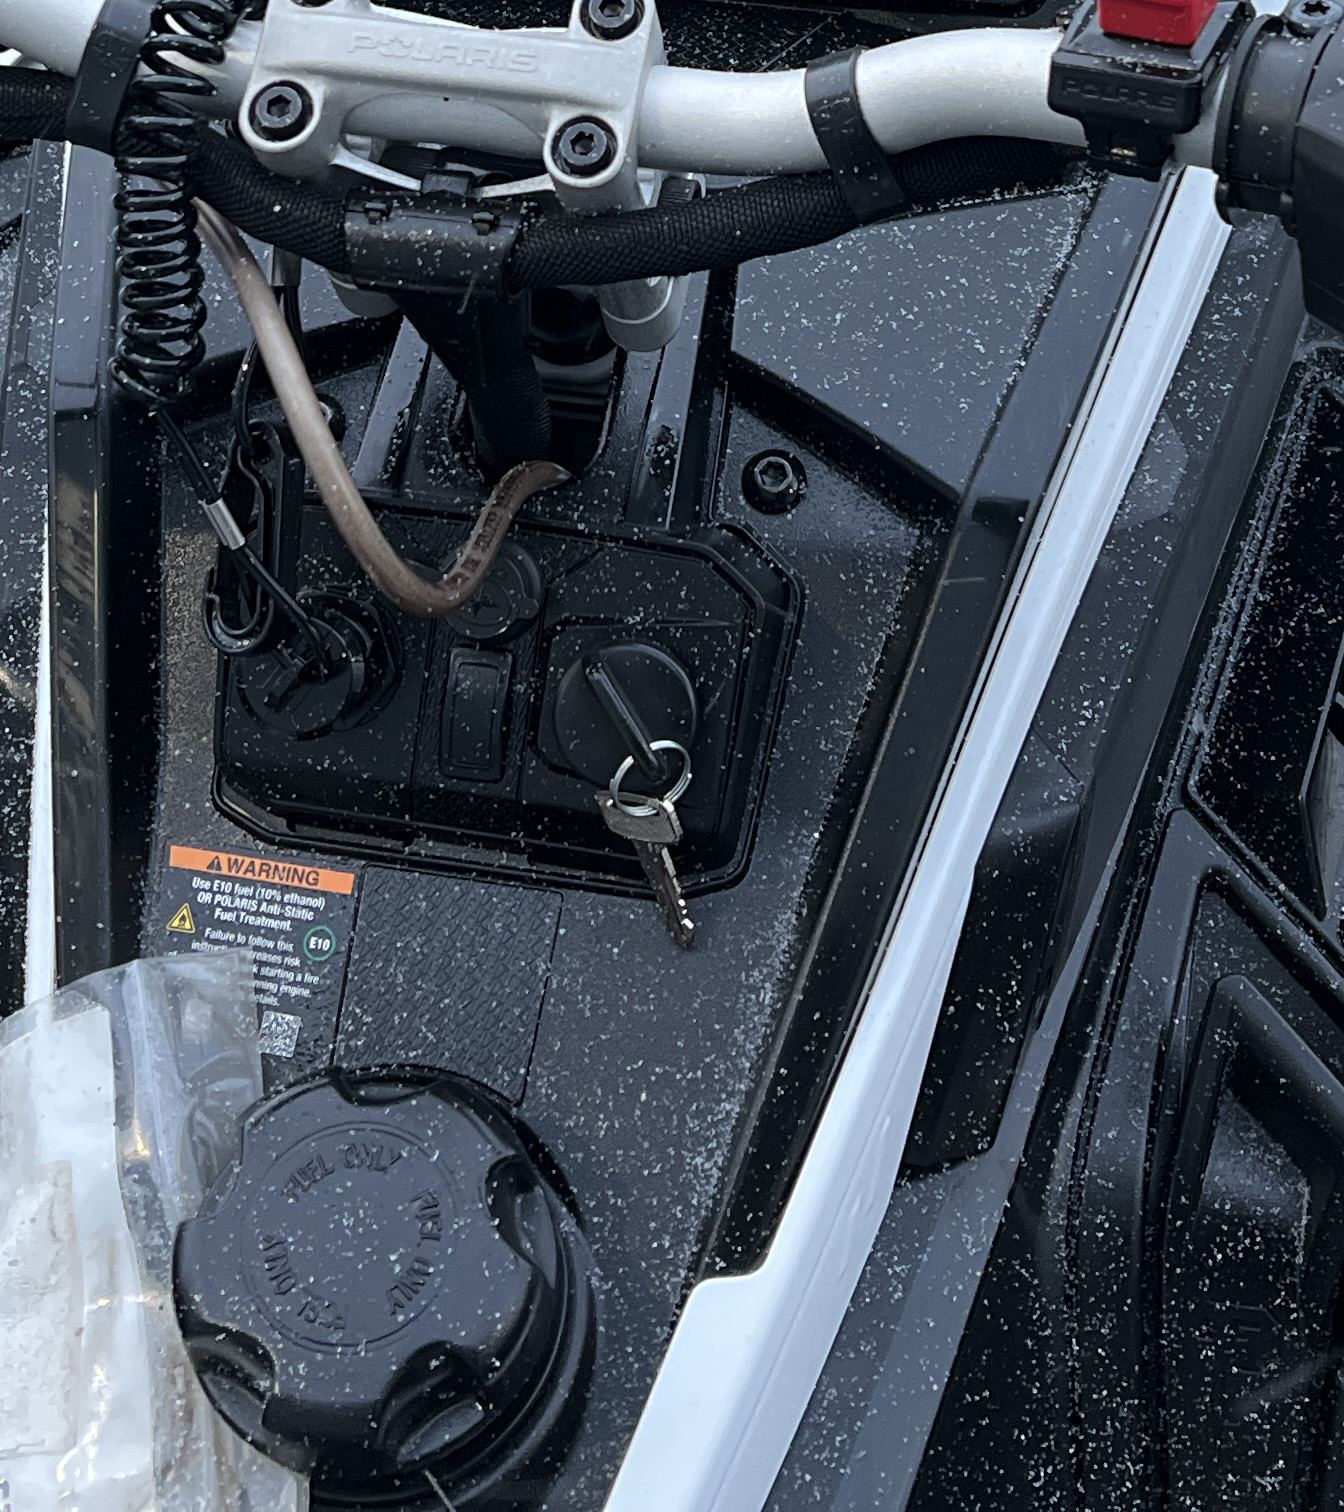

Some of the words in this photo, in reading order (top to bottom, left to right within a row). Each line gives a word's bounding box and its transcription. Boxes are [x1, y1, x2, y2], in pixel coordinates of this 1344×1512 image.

[348, 32, 538, 73] POLARIS
[227, 857, 319, 886] WARNING
[192, 877, 211, 890] Use
[213, 880, 232, 893] E10
[234, 883, 254, 897] fuel
[256, 886, 281, 901] (10%
[283, 894, 326, 910] ethanol)
[197, 892, 213, 905] OR
[214, 894, 258, 911] POLARIS
[259, 901, 314, 921] Anti-Static
[214, 907, 237, 921] Fuel
[239, 912, 293, 931] Treatment.
[205, 927, 235, 942] Failure
[237, 933, 247, 944] to
[248, 934, 275, 949] follow
[277, 938, 294, 952] this
[309, 938, 331, 951] E10
[284, 956, 301, 967] risk
[260, 967, 295, 982] starting
[303, 972, 320, 985] fire
[279, 983, 312, 998] engine.
[281, 1153, 335, 1202] FUEL
[343, 1143, 403, 1175] ONLY
[262, 1236, 298, 1296] ONLY
